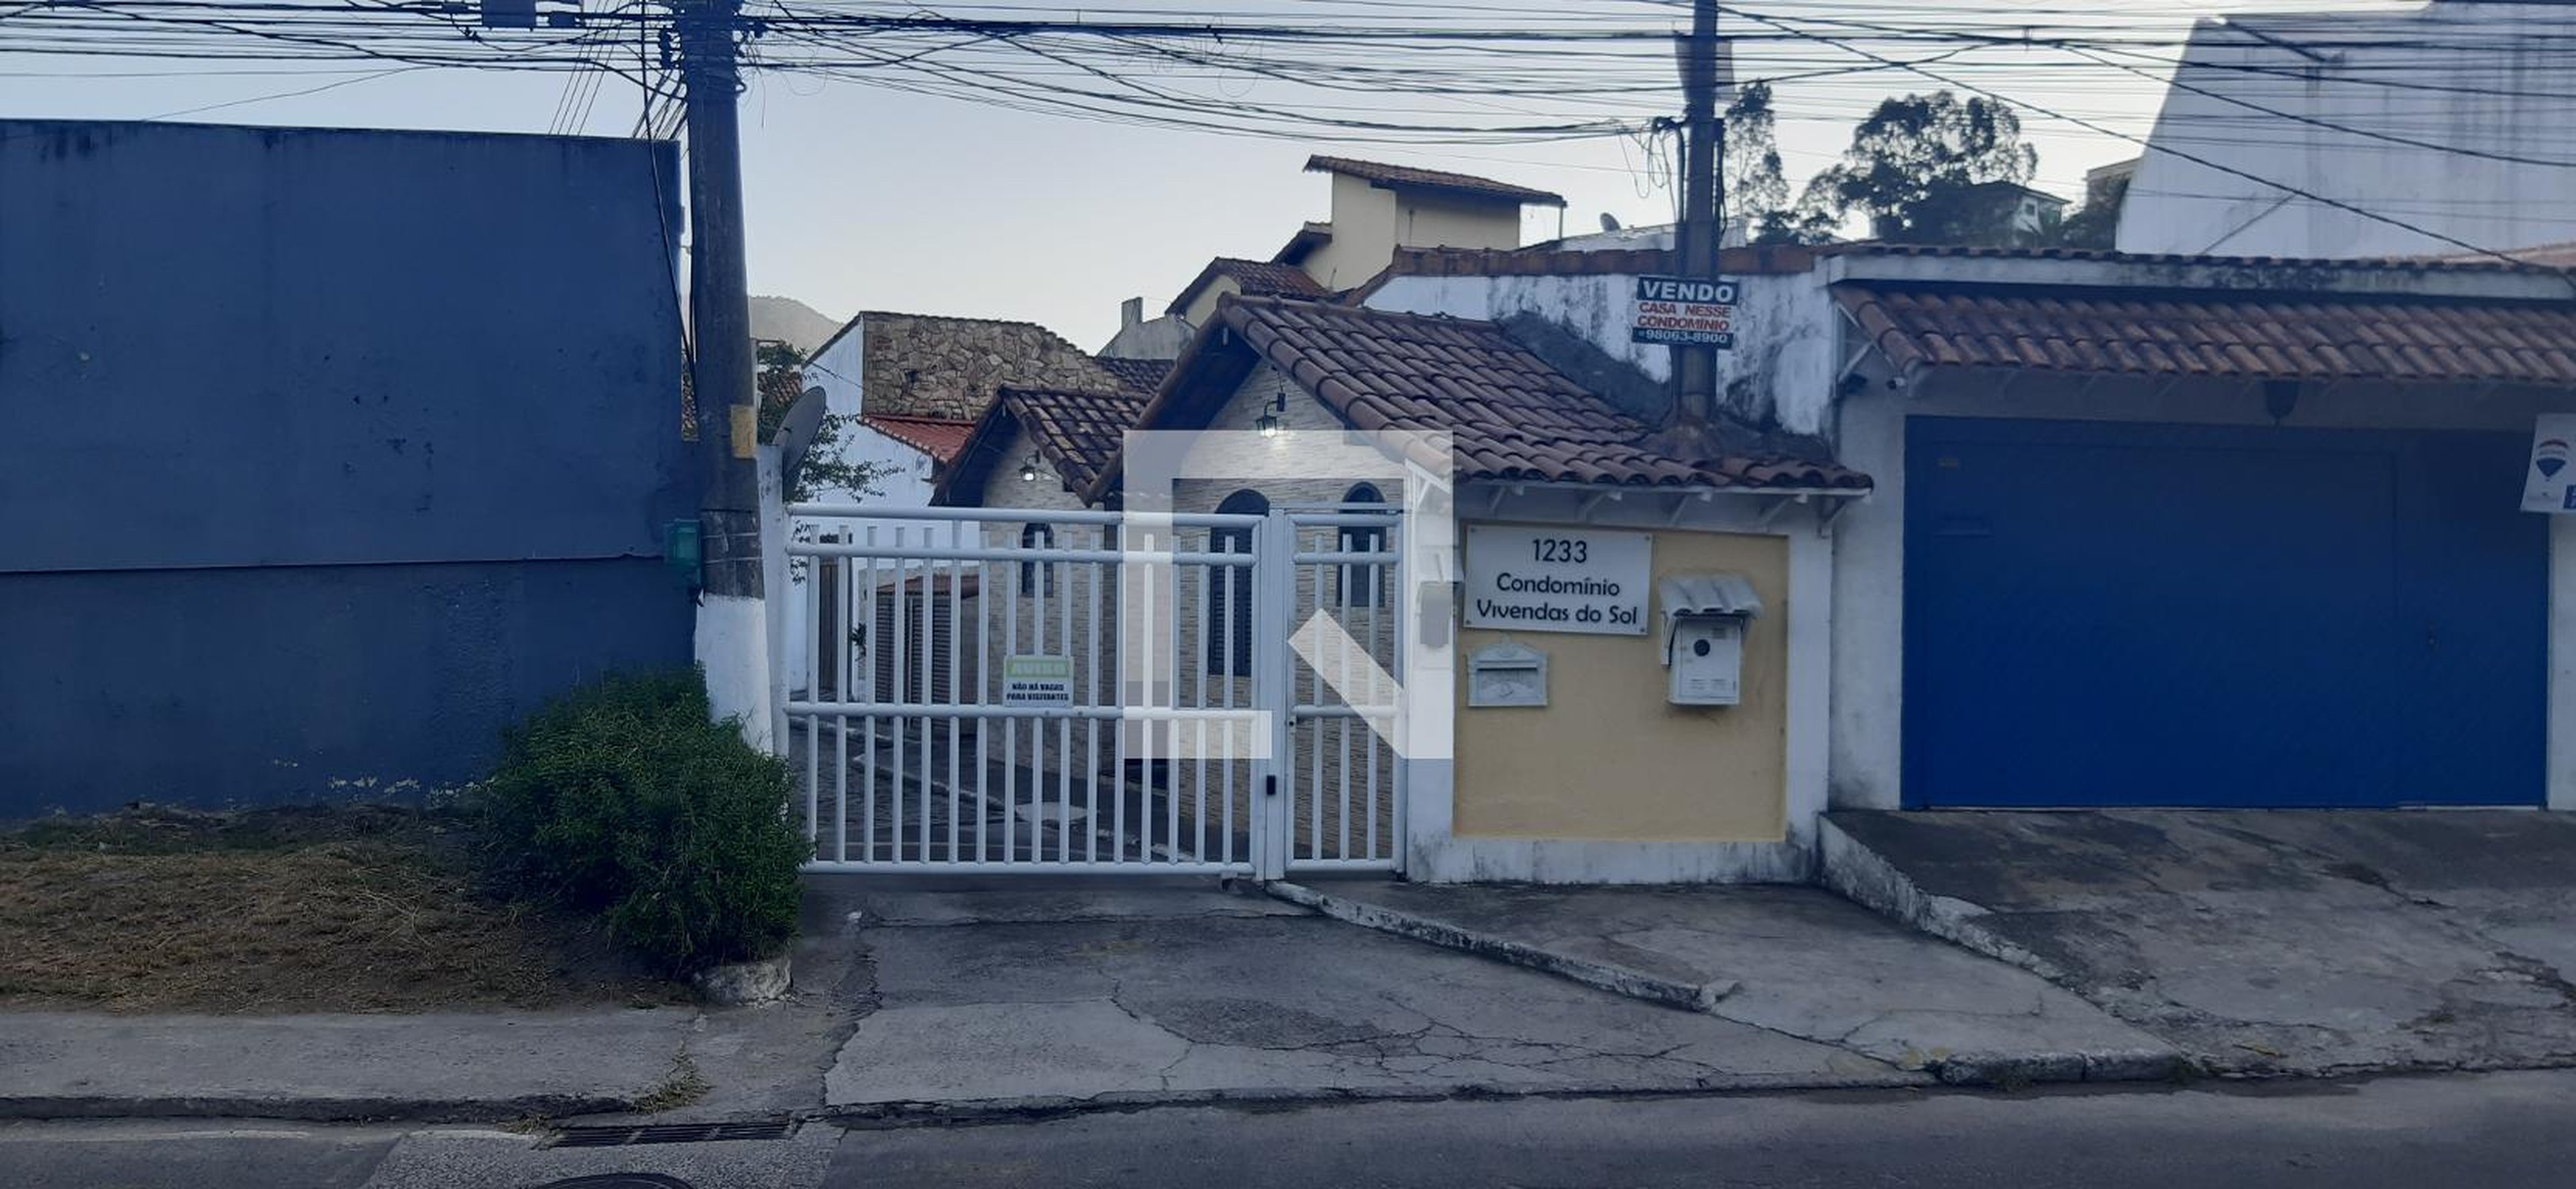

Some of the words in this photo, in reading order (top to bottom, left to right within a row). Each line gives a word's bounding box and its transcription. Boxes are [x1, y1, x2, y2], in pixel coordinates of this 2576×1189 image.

[1644, 281, 1734, 302] VENDO
[1639, 302, 1676, 314] CASA
[1684, 305, 1731, 318] NESSE
[1533, 539, 1587, 563] 1233
[1497, 572, 1620, 597] Condomínio
[1477, 599, 1568, 621] Vivendas
[1575, 605, 1601, 624] do
[1609, 606, 1638, 624] Sol
